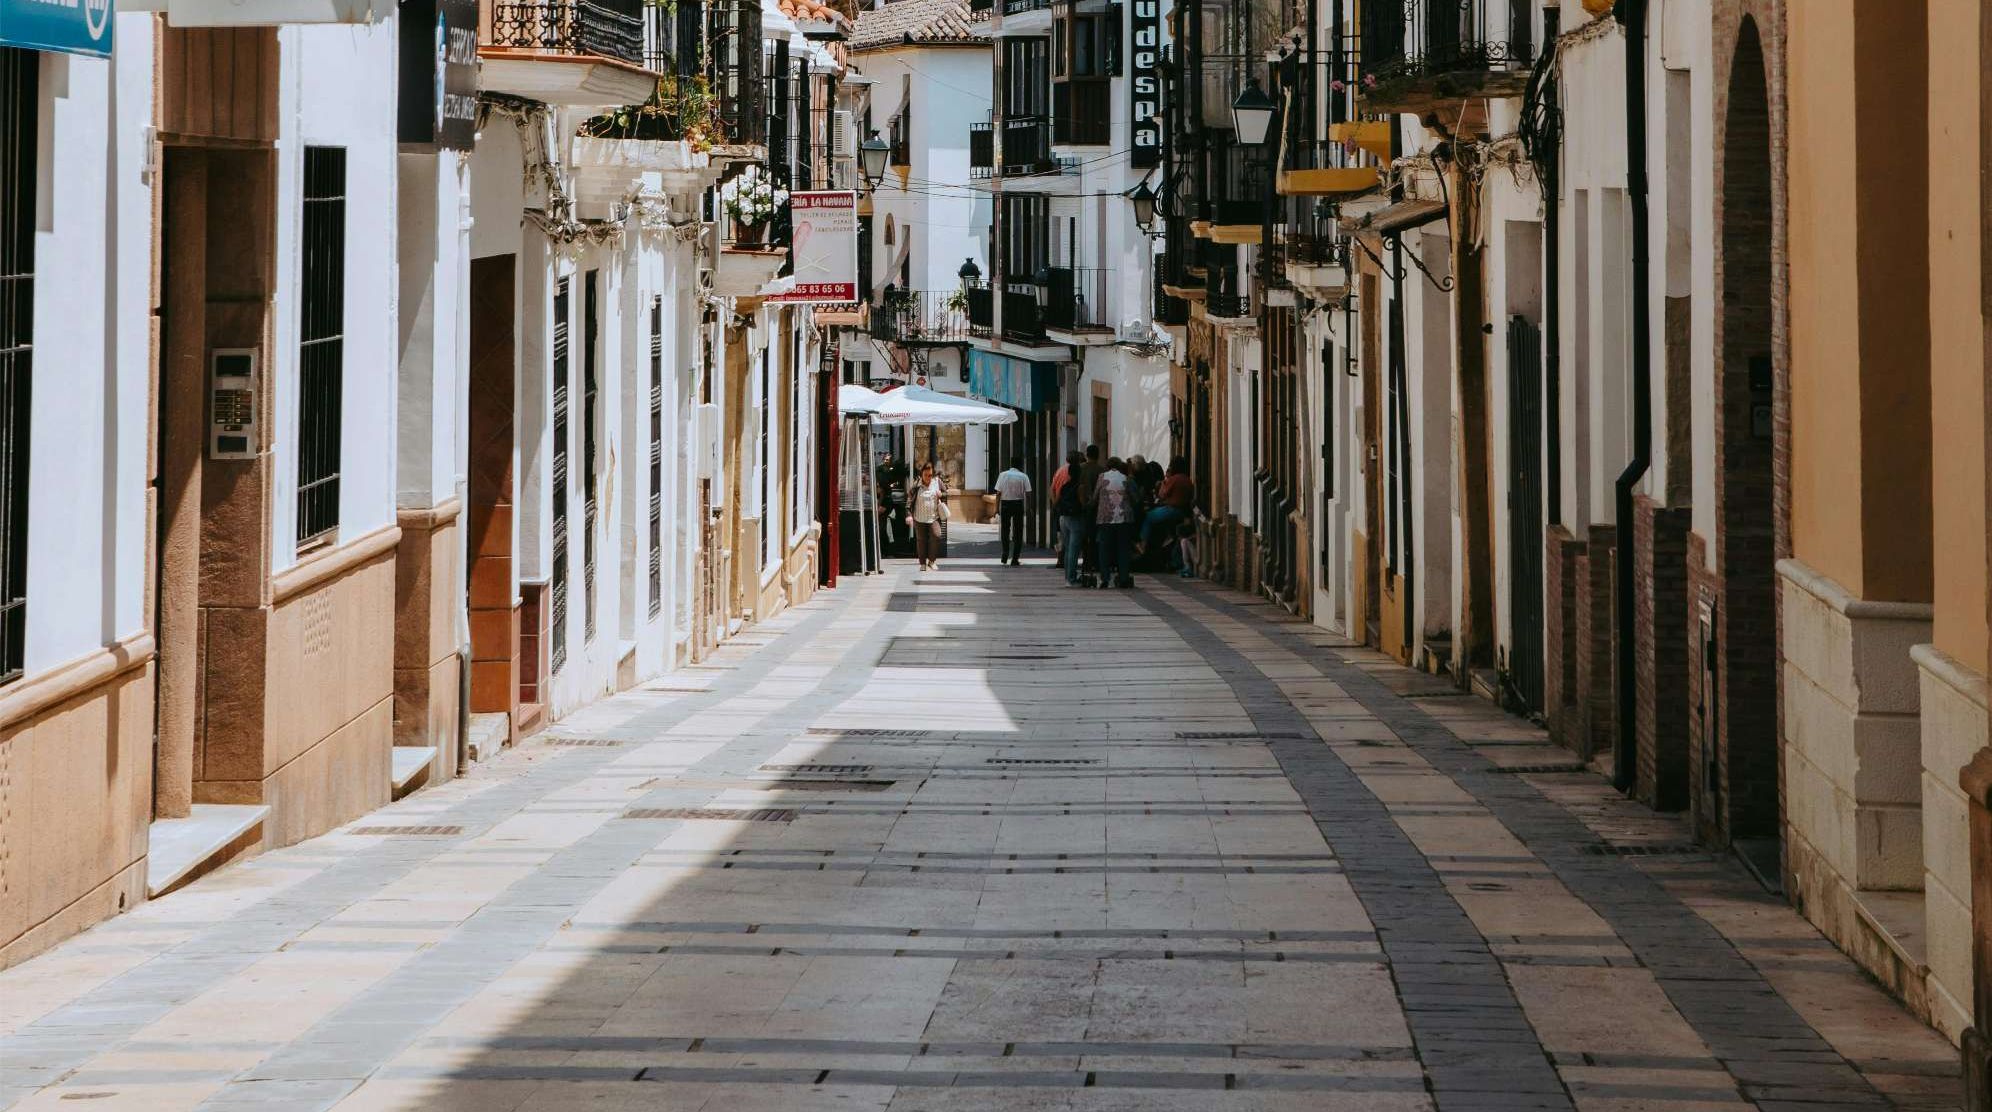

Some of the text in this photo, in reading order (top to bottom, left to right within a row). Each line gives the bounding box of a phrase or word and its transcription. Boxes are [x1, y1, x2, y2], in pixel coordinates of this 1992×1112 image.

[811, 197, 821, 206] LA
[809, 284, 819, 293] 83
[822, 284, 832, 293] 65
[834, 284, 845, 293] 06
